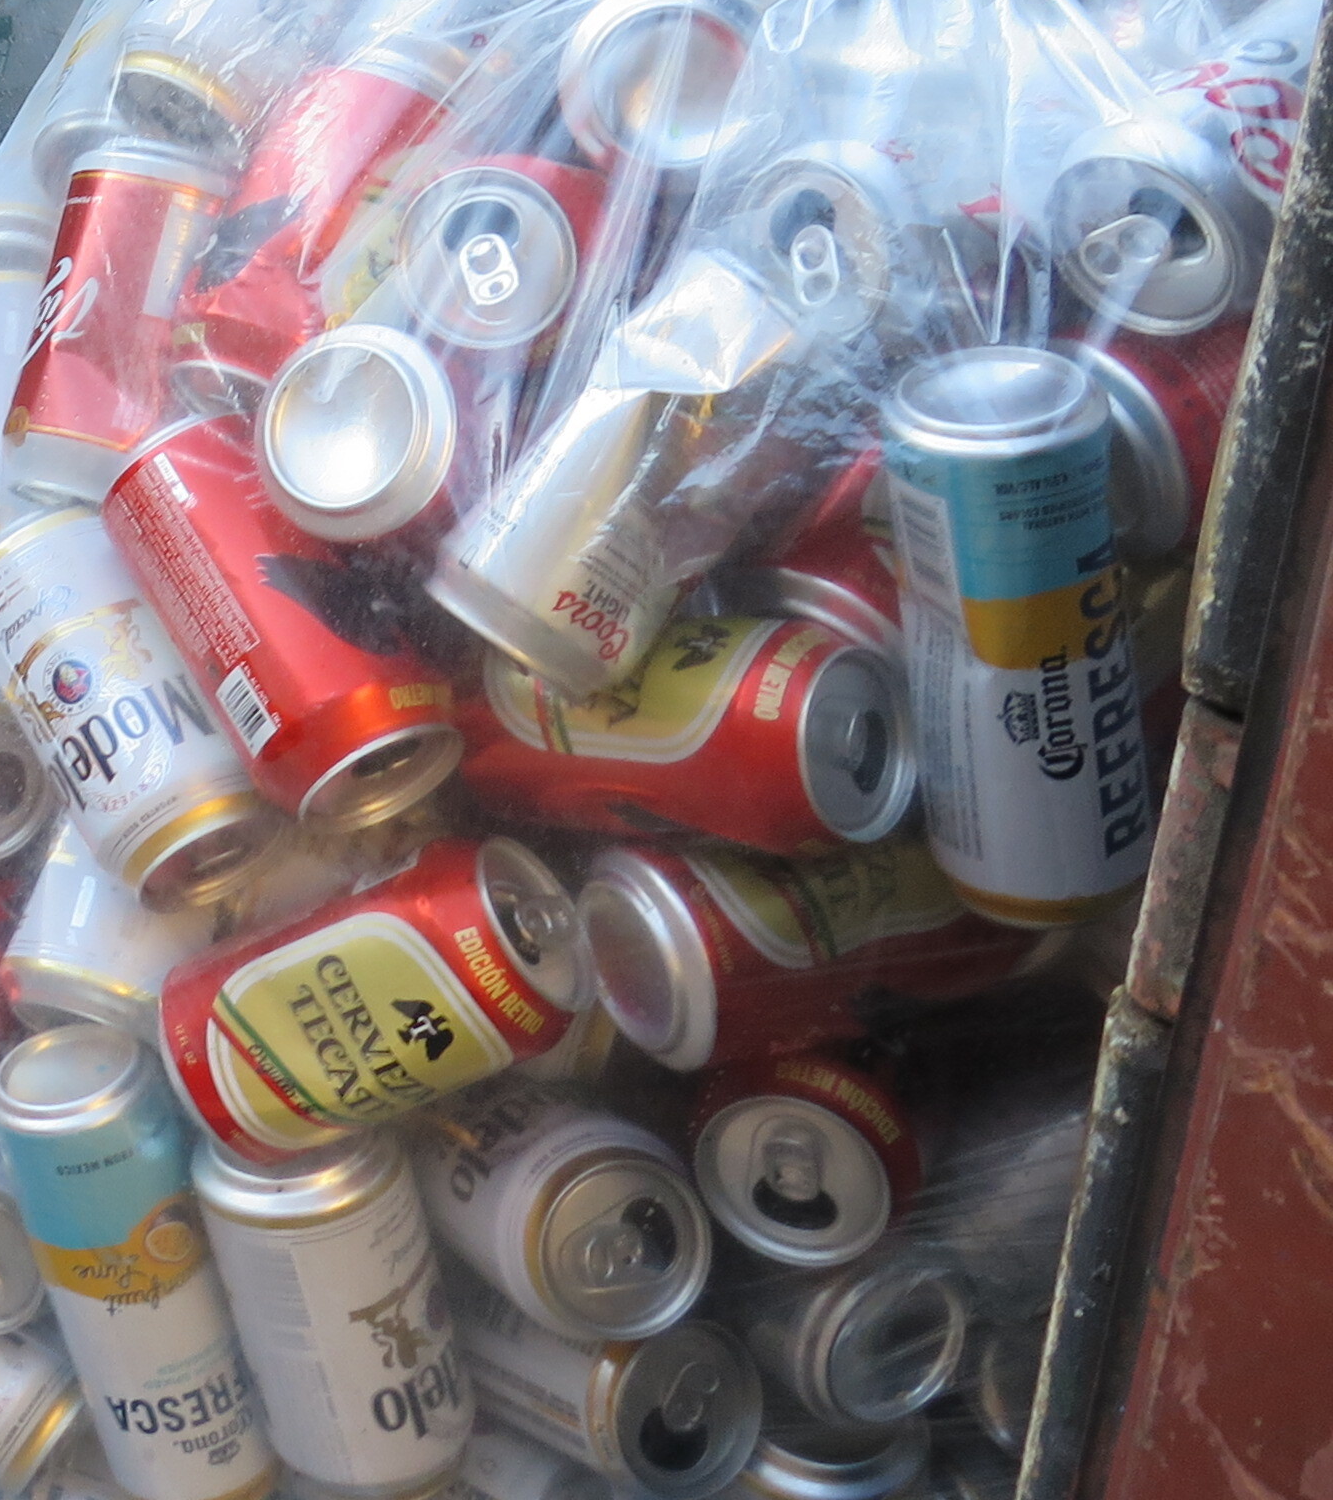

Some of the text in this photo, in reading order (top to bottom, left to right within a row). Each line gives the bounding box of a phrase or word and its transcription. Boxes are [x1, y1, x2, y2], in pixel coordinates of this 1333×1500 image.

[552, 590, 630, 666] Coors
[1039, 645, 1090, 780] Corona
[1075, 534, 1150, 860] REFRESCA
[454, 926, 546, 1035] EDICIÓN RETRO
